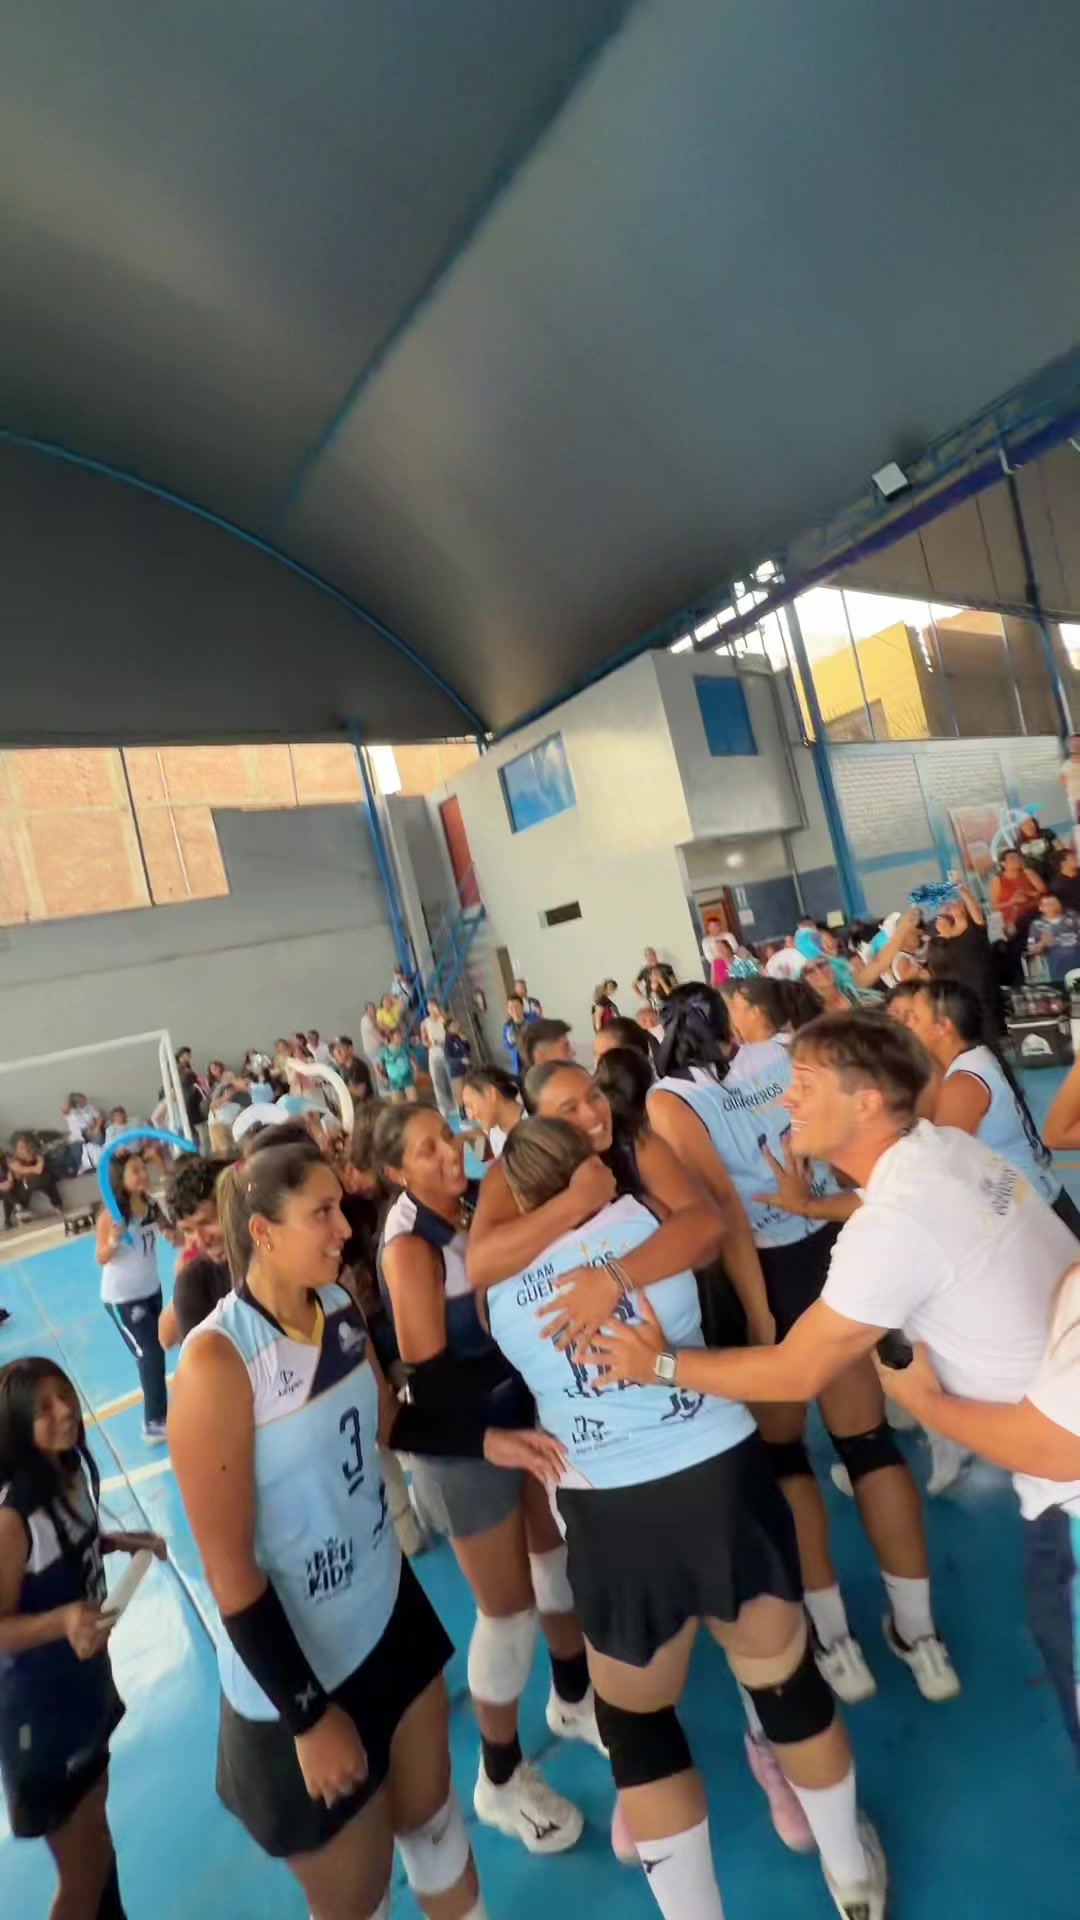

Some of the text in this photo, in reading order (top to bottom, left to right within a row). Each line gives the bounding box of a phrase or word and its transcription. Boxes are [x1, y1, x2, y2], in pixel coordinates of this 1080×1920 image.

[516, 1250, 615, 1308] GUEOS
[522, 1261, 556, 1286] TEAM
[339, 1405, 364, 1482] 3
